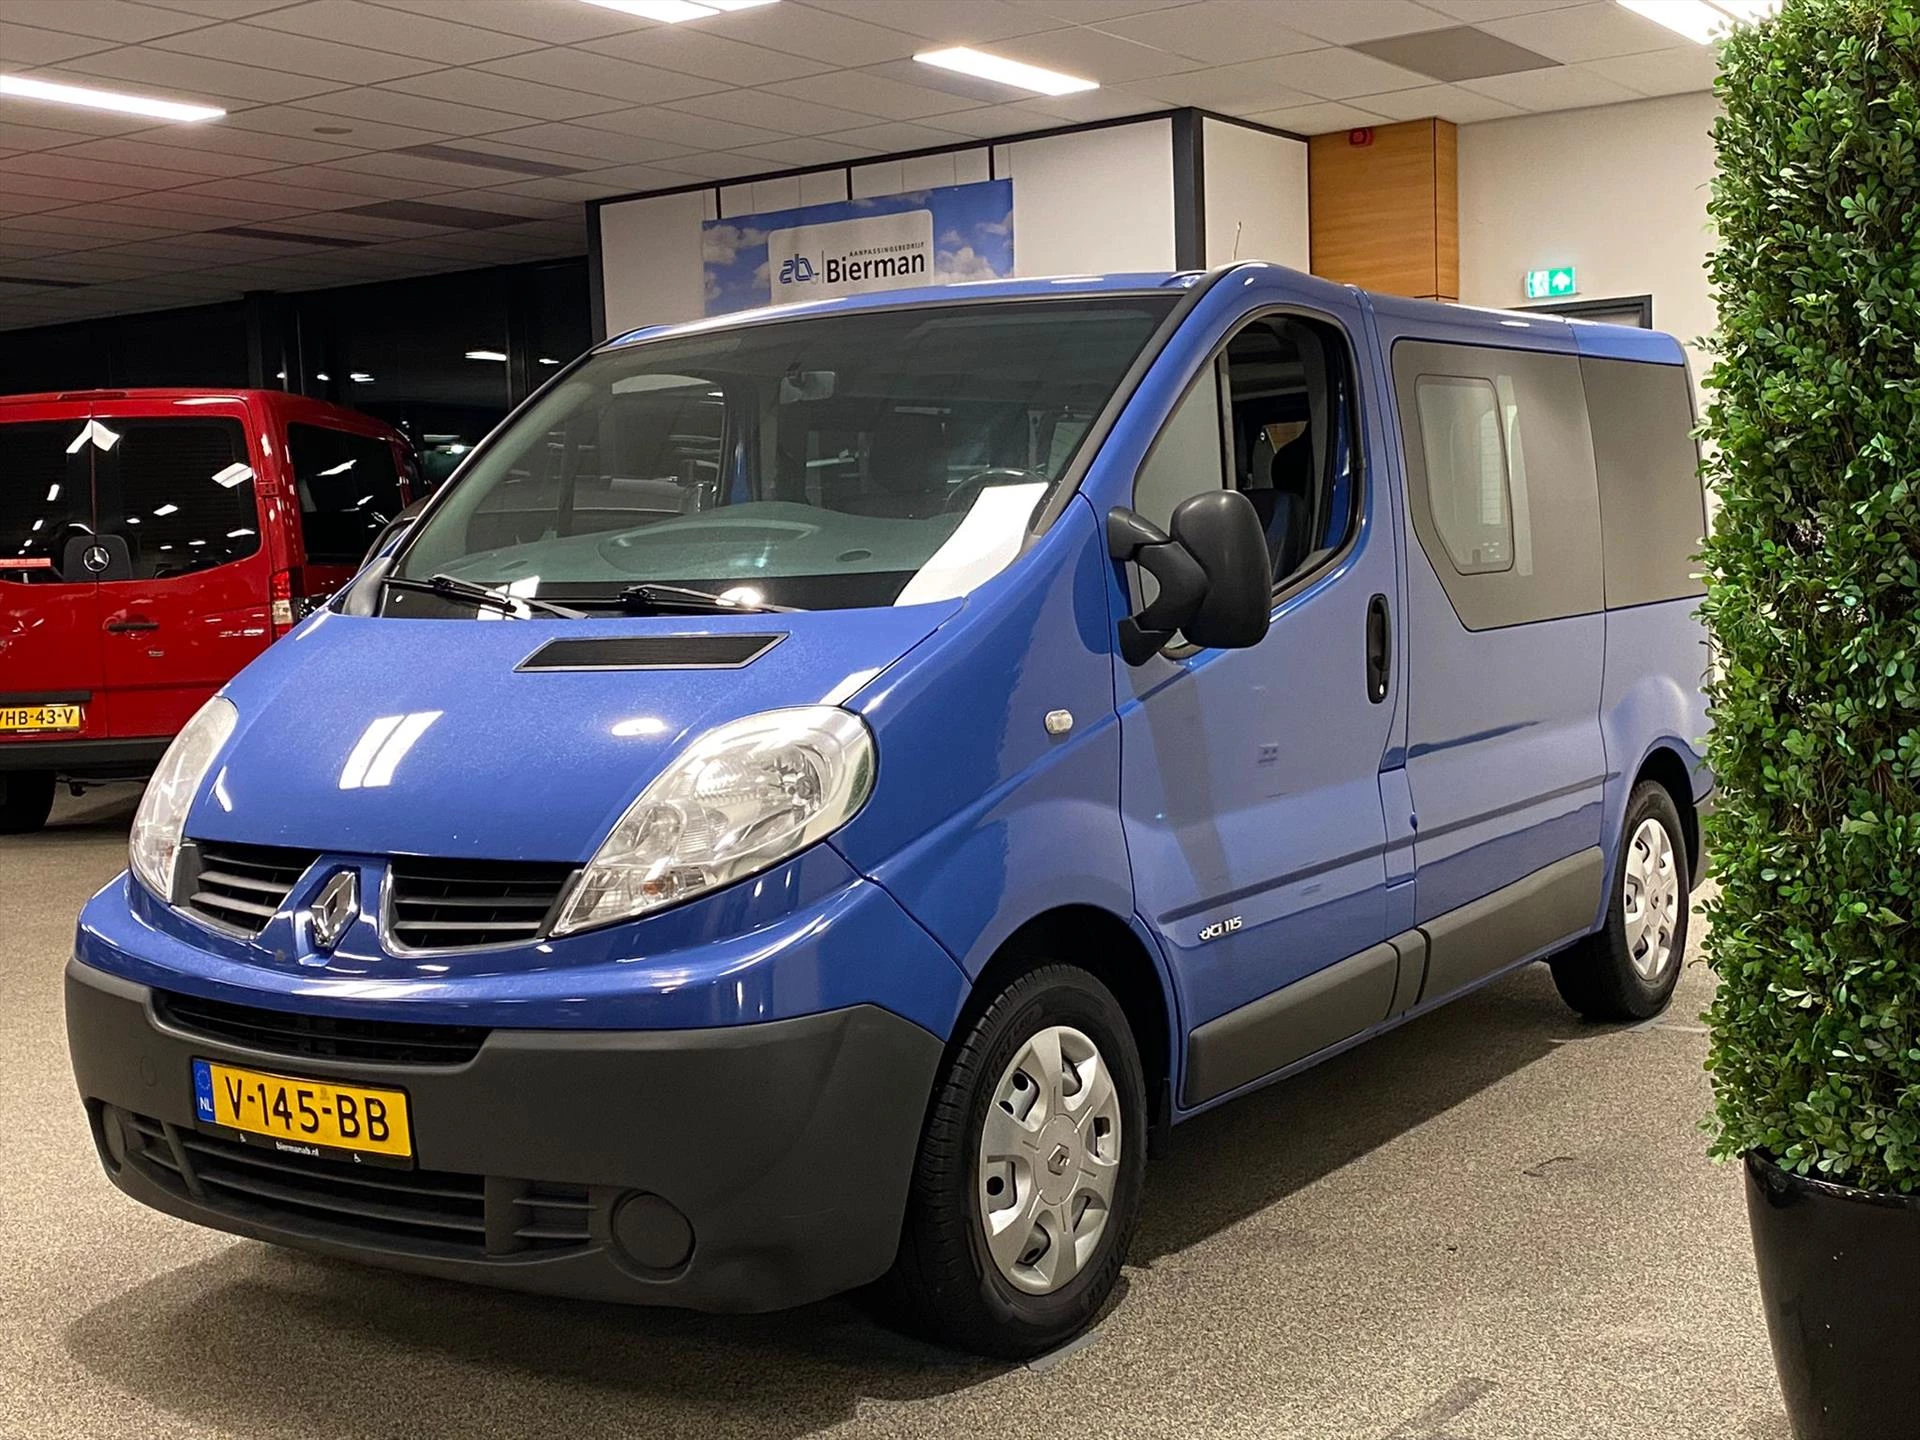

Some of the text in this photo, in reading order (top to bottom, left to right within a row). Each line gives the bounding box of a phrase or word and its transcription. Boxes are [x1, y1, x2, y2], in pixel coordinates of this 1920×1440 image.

[826, 253, 925, 284] Bierman
[1224, 916, 1242, 932] 115
[199, 1096, 213, 1112] NL
[225, 1075, 390, 1142] V-145-BB
